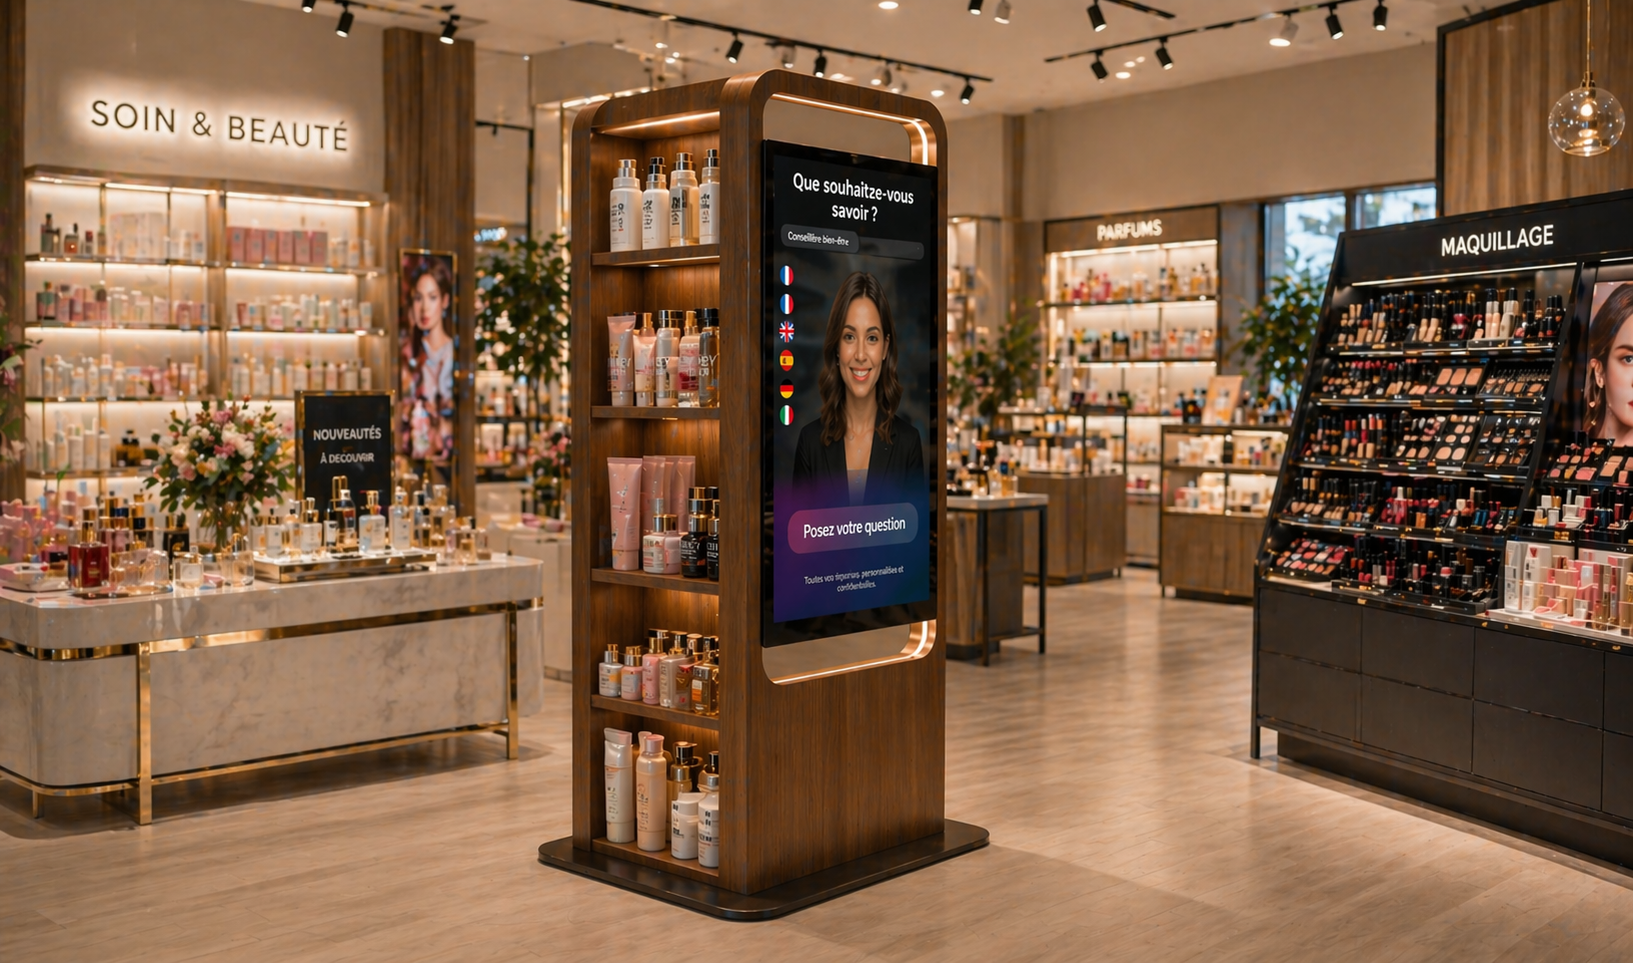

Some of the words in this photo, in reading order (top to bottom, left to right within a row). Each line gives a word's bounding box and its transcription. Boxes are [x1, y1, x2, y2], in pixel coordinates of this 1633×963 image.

[91, 100, 175, 133] SOIN
[192, 111, 212, 137] &
[228, 115, 348, 152] BEAUTÉ
[793, 172, 820, 192] Que
[823, 178, 914, 204] souhaitze-vous
[831, 204, 869, 221] savoir
[871, 206, 878, 222] ?
[1096, 218, 1163, 242] PARFUMS
[1441, 224, 1554, 257] MAQUILLAGE
[313, 424, 382, 441] NOUVEAUTÉS
[803, 523, 834, 539] Posez
[836, 520, 863, 536] votre
[864, 516, 906, 537] question
